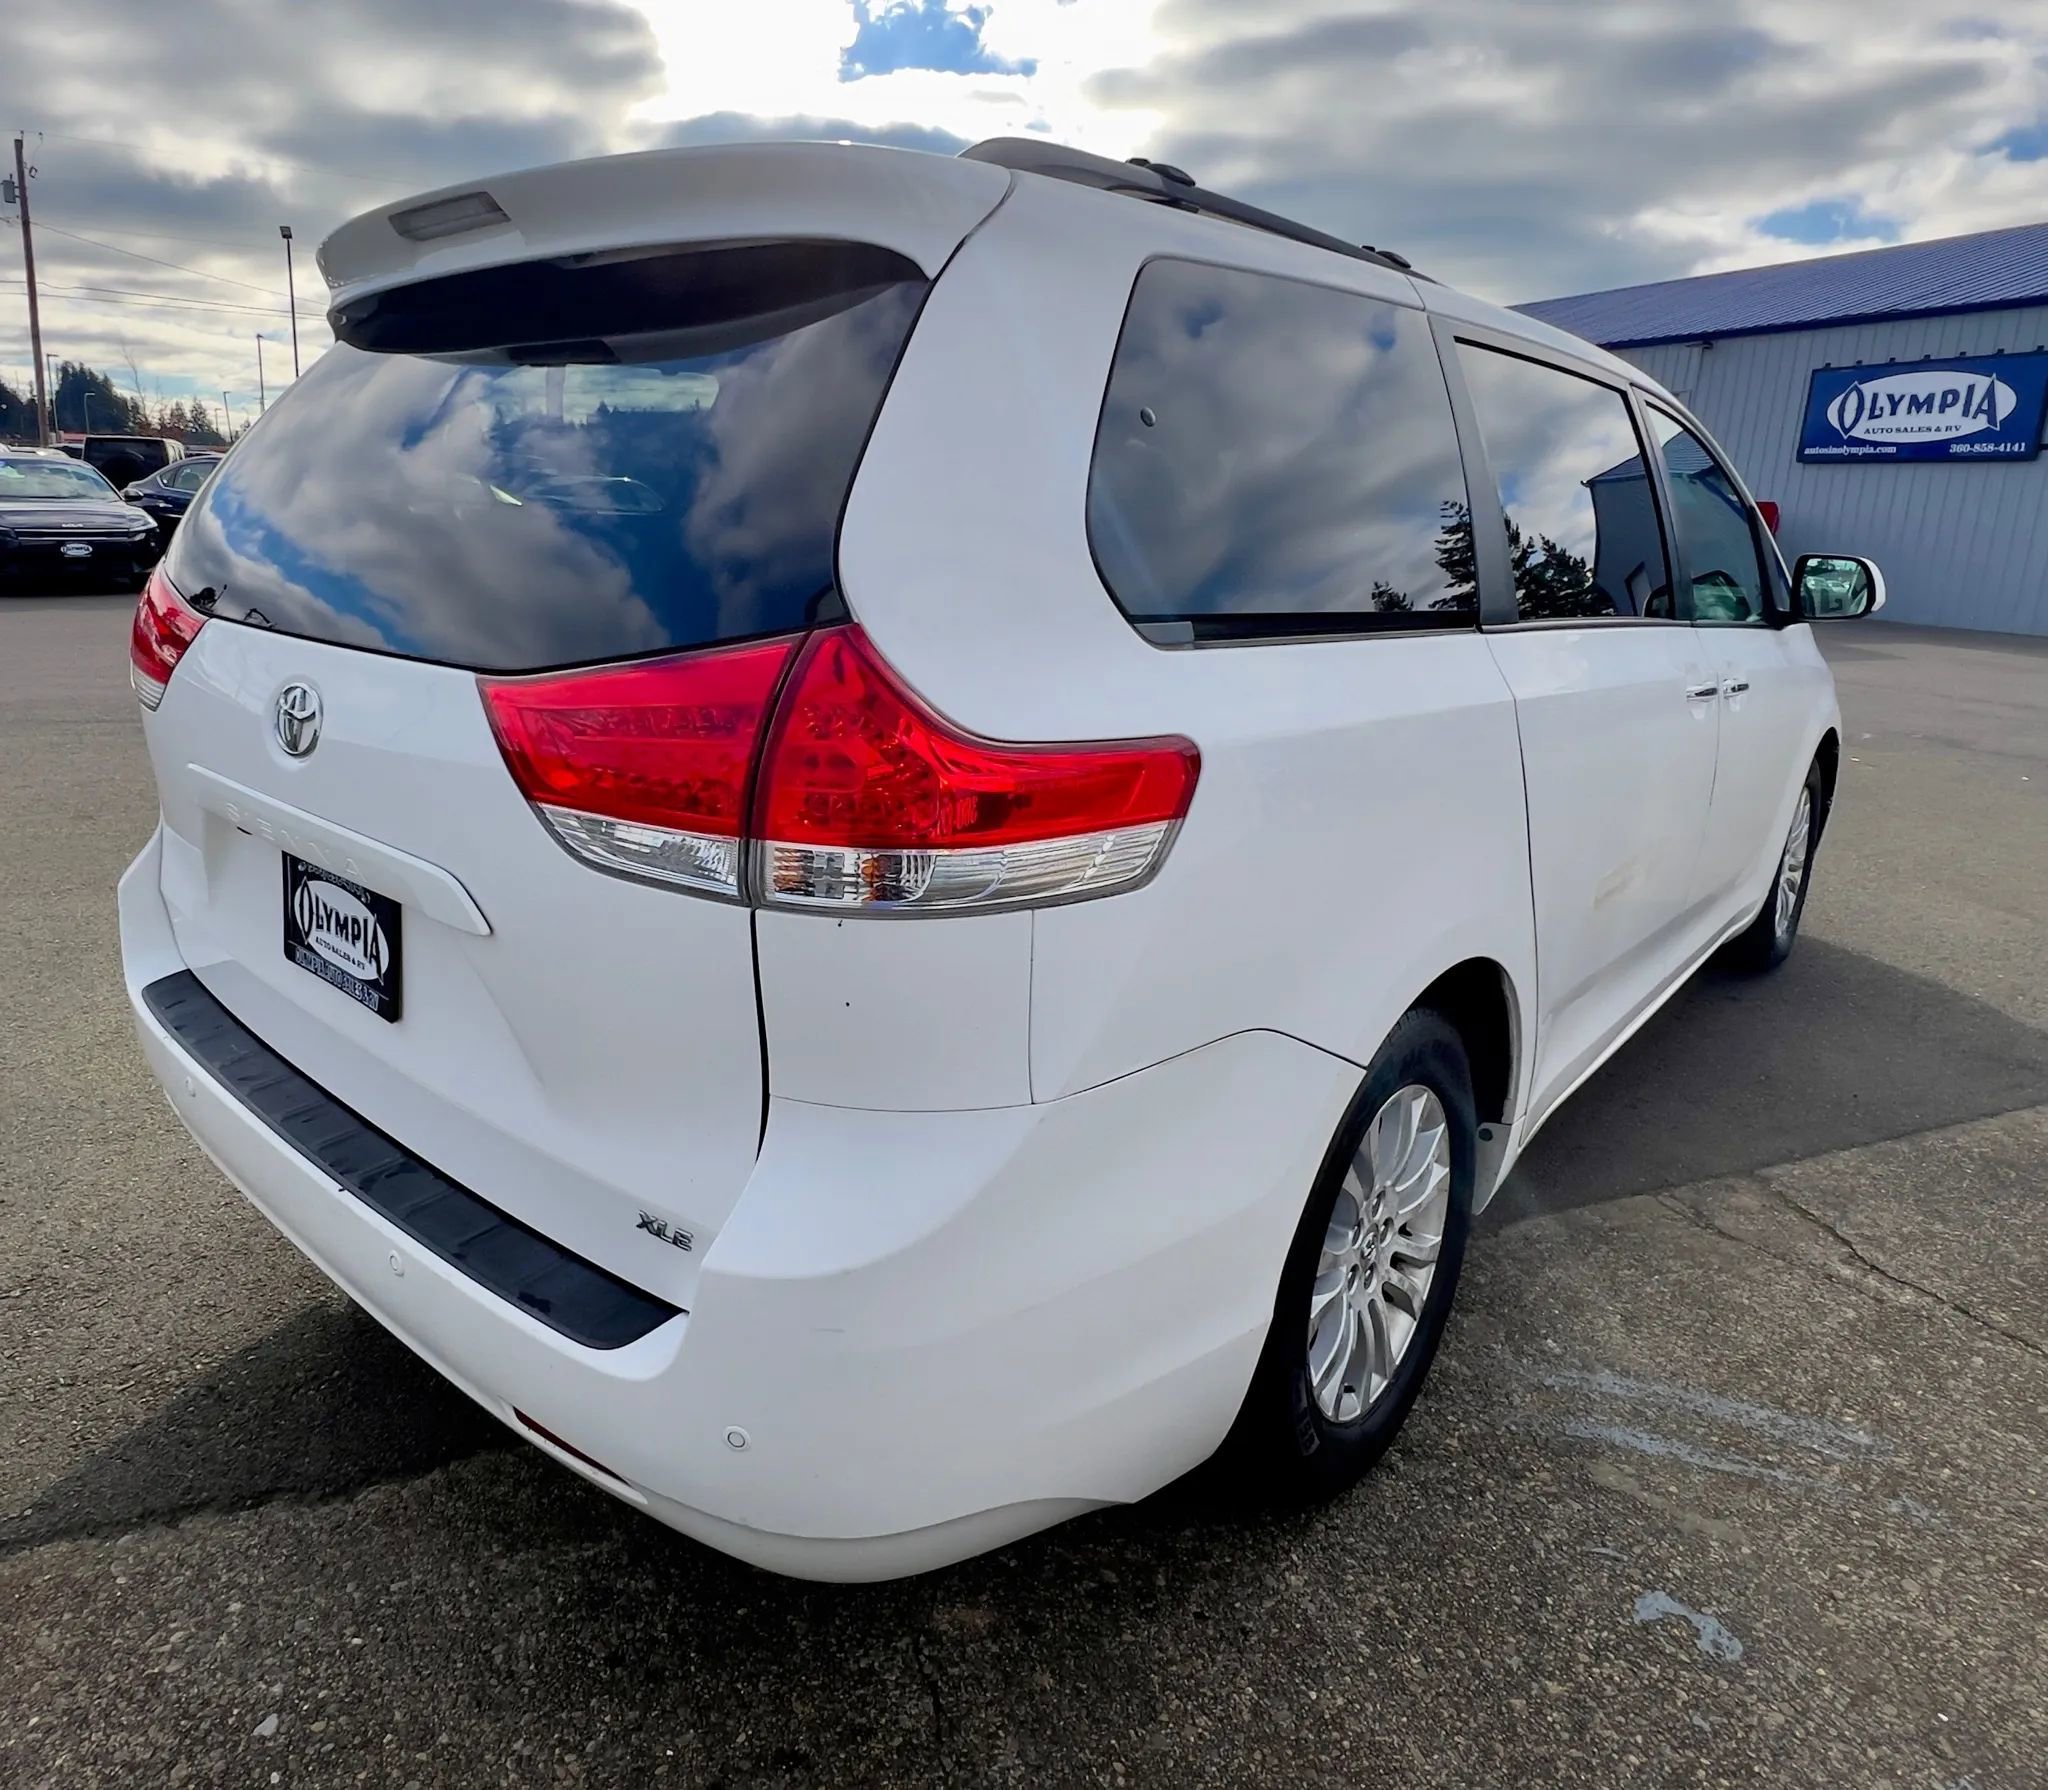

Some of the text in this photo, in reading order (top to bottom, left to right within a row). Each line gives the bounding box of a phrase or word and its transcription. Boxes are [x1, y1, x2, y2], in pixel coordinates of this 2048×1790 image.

[1837, 376, 2000, 438] OLYMPIA
[1804, 444, 1897, 456] autosinolympia.com
[1863, 424, 1962, 435] AUTO SALES & RV
[1949, 441, 2026, 454] 360-858-4141
[225, 801, 369, 884] SENNA
[299, 877, 384, 984] OLYMPIA
[636, 1209, 695, 1252] XLE
